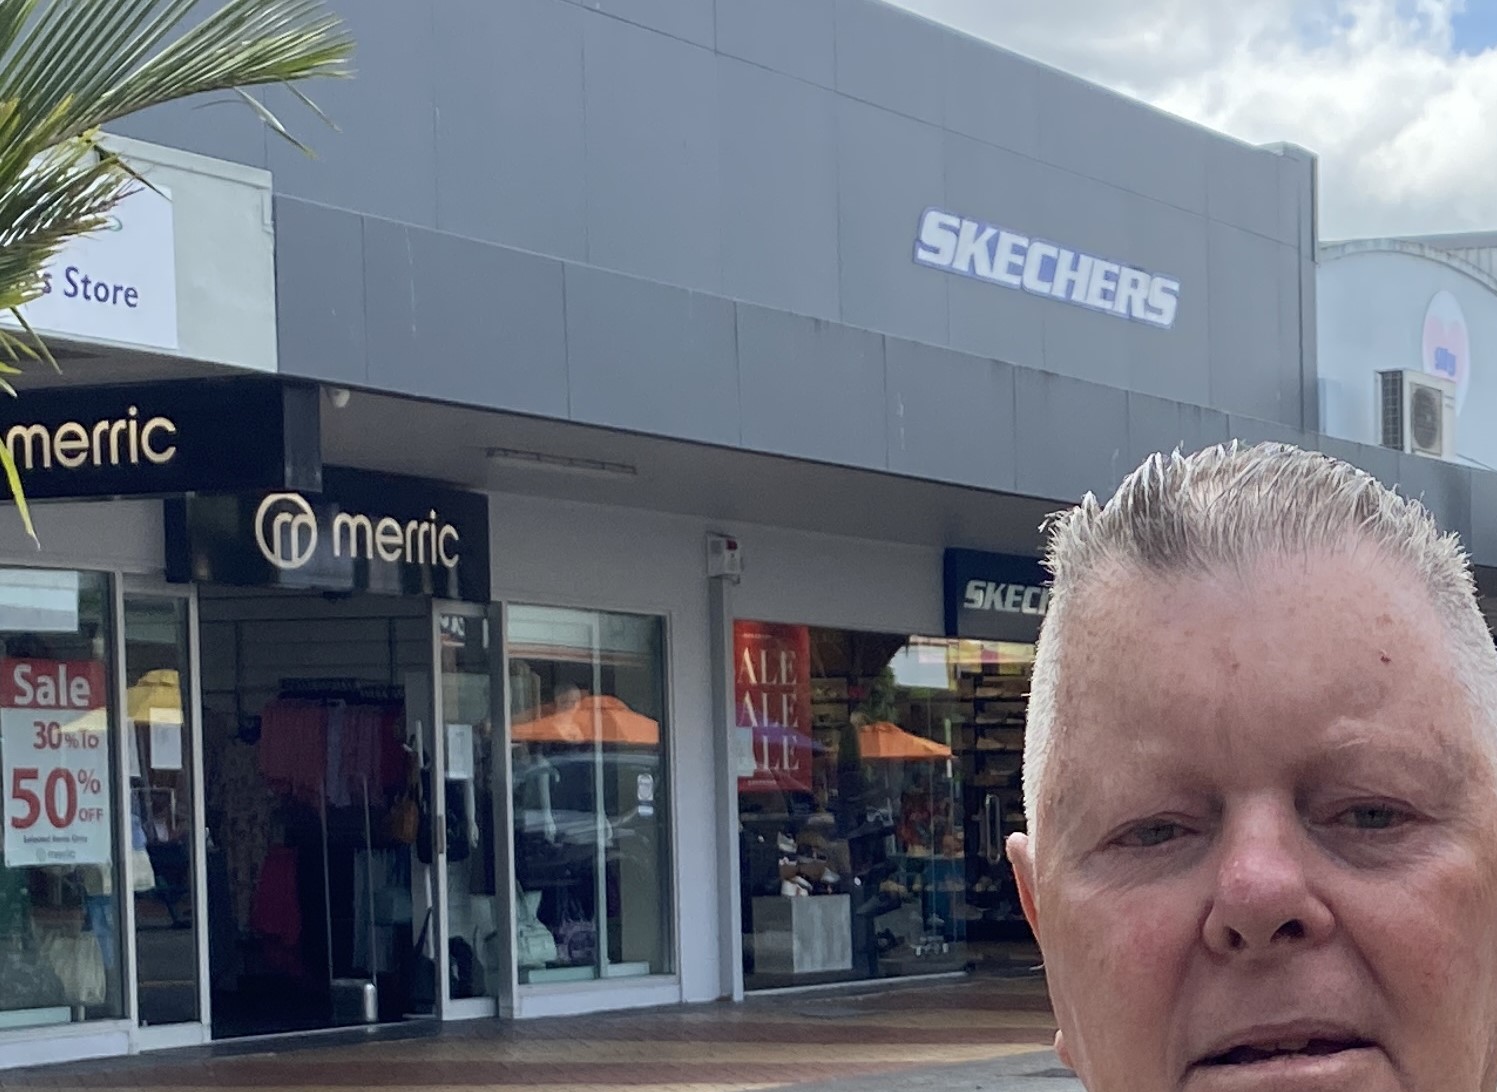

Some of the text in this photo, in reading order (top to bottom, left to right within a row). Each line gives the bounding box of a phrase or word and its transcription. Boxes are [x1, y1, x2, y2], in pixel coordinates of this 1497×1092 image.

[64, 266, 139, 308] Store
[915, 208, 1181, 327] SKECHERS
[6, 405, 177, 469] merric
[333, 508, 460, 568] merric
[13, 663, 91, 706] Sale
[737, 647, 798, 684] ALE
[739, 690, 799, 727] ALE
[78, 807, 104, 822] OFF
